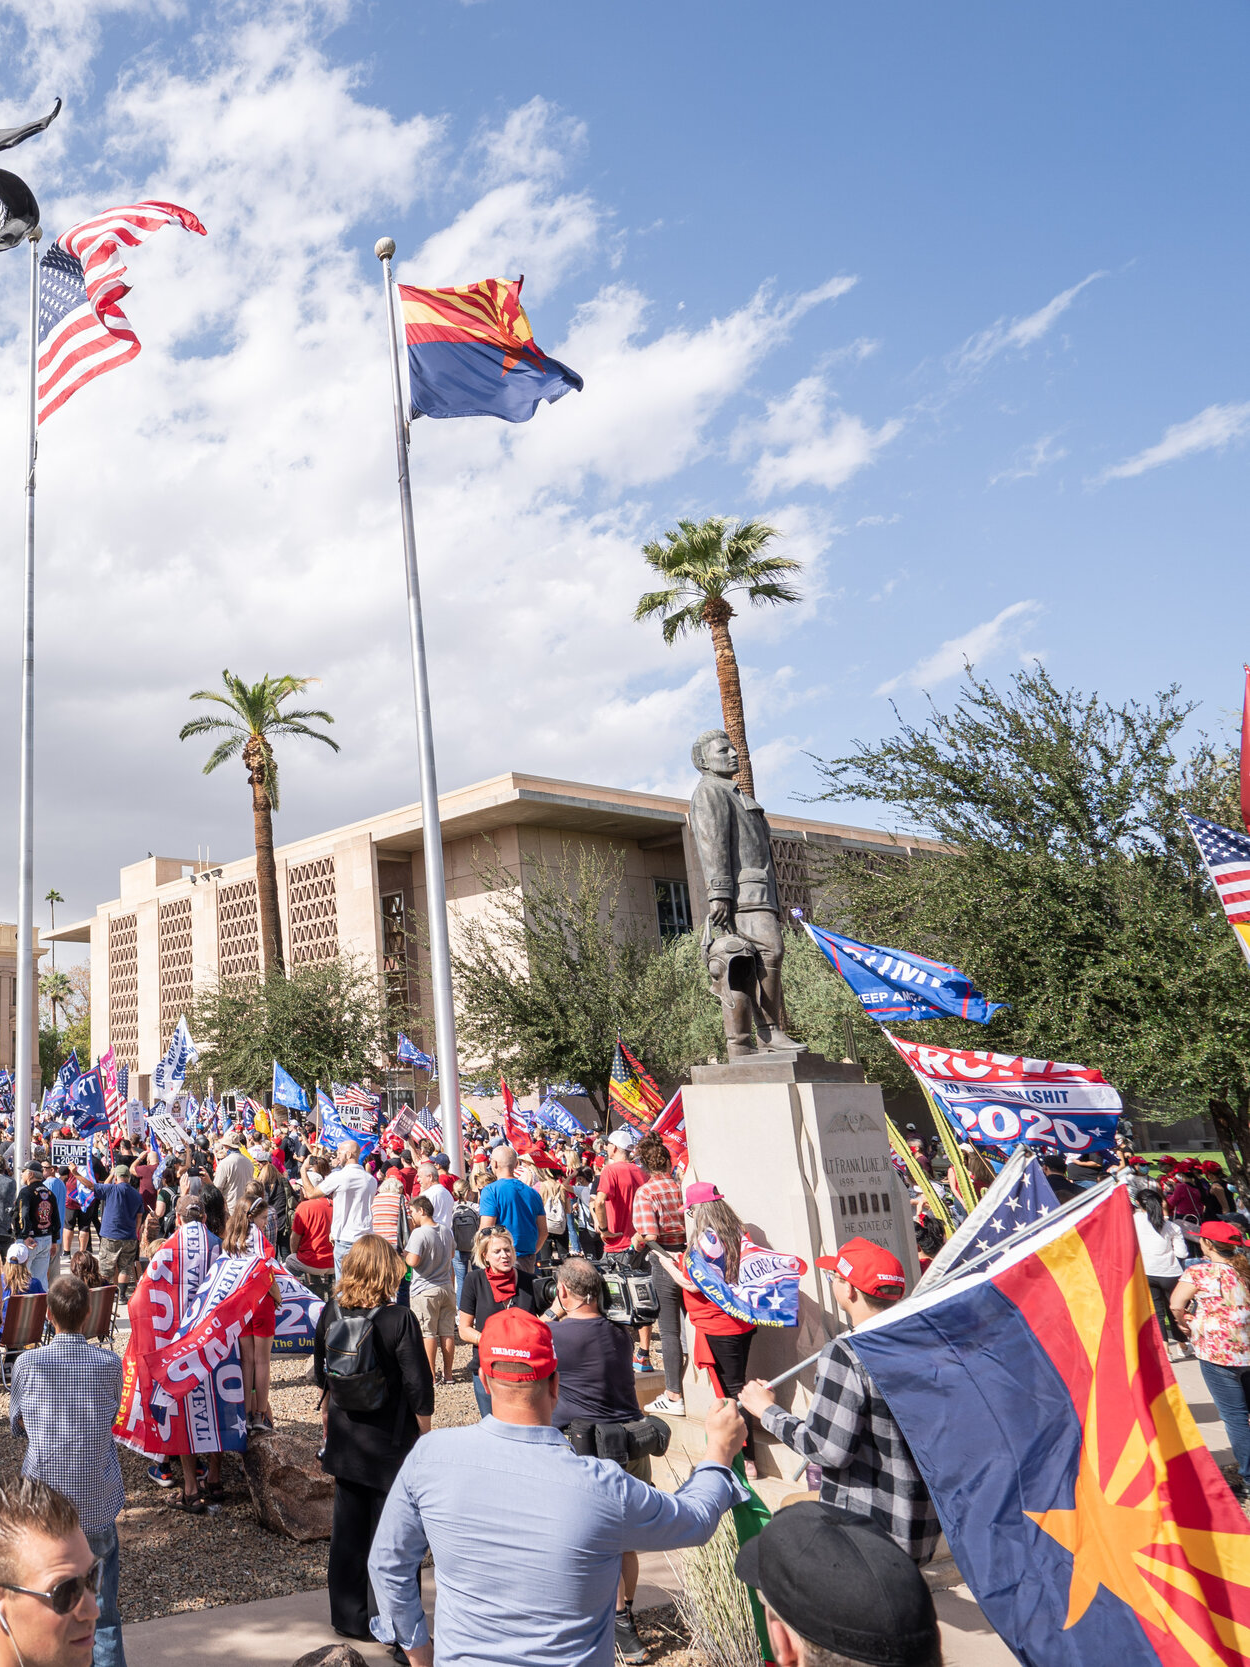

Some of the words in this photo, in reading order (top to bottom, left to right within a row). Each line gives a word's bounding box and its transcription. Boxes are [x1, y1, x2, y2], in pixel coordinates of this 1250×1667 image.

[953, 1105, 1093, 1150] 2020
[663, 1129, 682, 1144] MAKE
[53, 1144, 88, 1157] TRUMP
[60, 1155, 81, 1165] 2020
[835, 1156, 862, 1174] FRANK
[858, 1221, 881, 1232] STATE
[883, 1219, 893, 1231] OF
[274, 1339, 294, 1349] The
[490, 1346, 531, 1358] TRUMP2020
